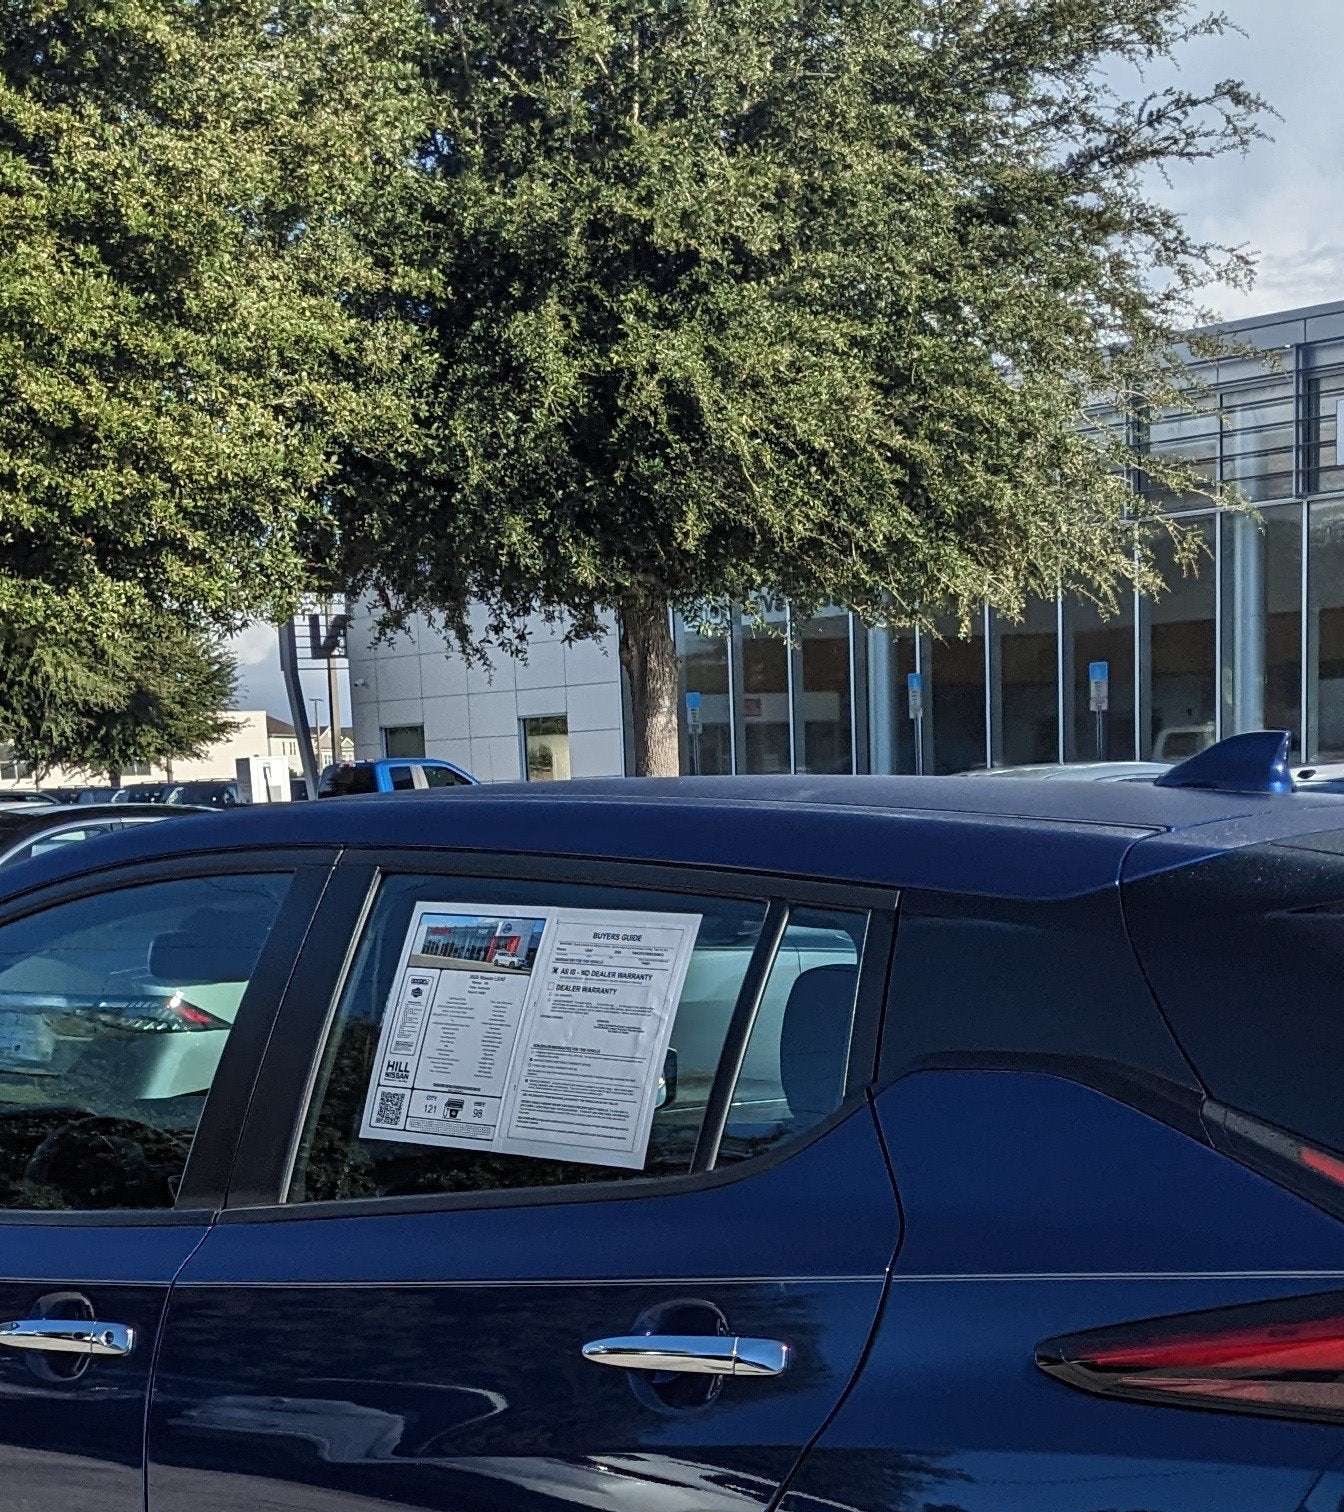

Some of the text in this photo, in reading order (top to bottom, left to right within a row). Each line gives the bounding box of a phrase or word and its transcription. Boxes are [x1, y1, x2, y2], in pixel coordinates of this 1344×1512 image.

[592, 931, 643, 943] BUYERS GUIDE
[560, 967, 569, 975] AS
[570, 968, 577, 976] IS
[591, 969, 617, 979] DEALER
[617, 972, 653, 982] WARRANTY
[556, 984, 581, 993] DEALER
[581, 986, 618, 996] WARRANTY
[386, 1060, 410, 1073] HILL
[384, 1072, 409, 1080] NISSAN
[424, 1104, 437, 1114] 121
